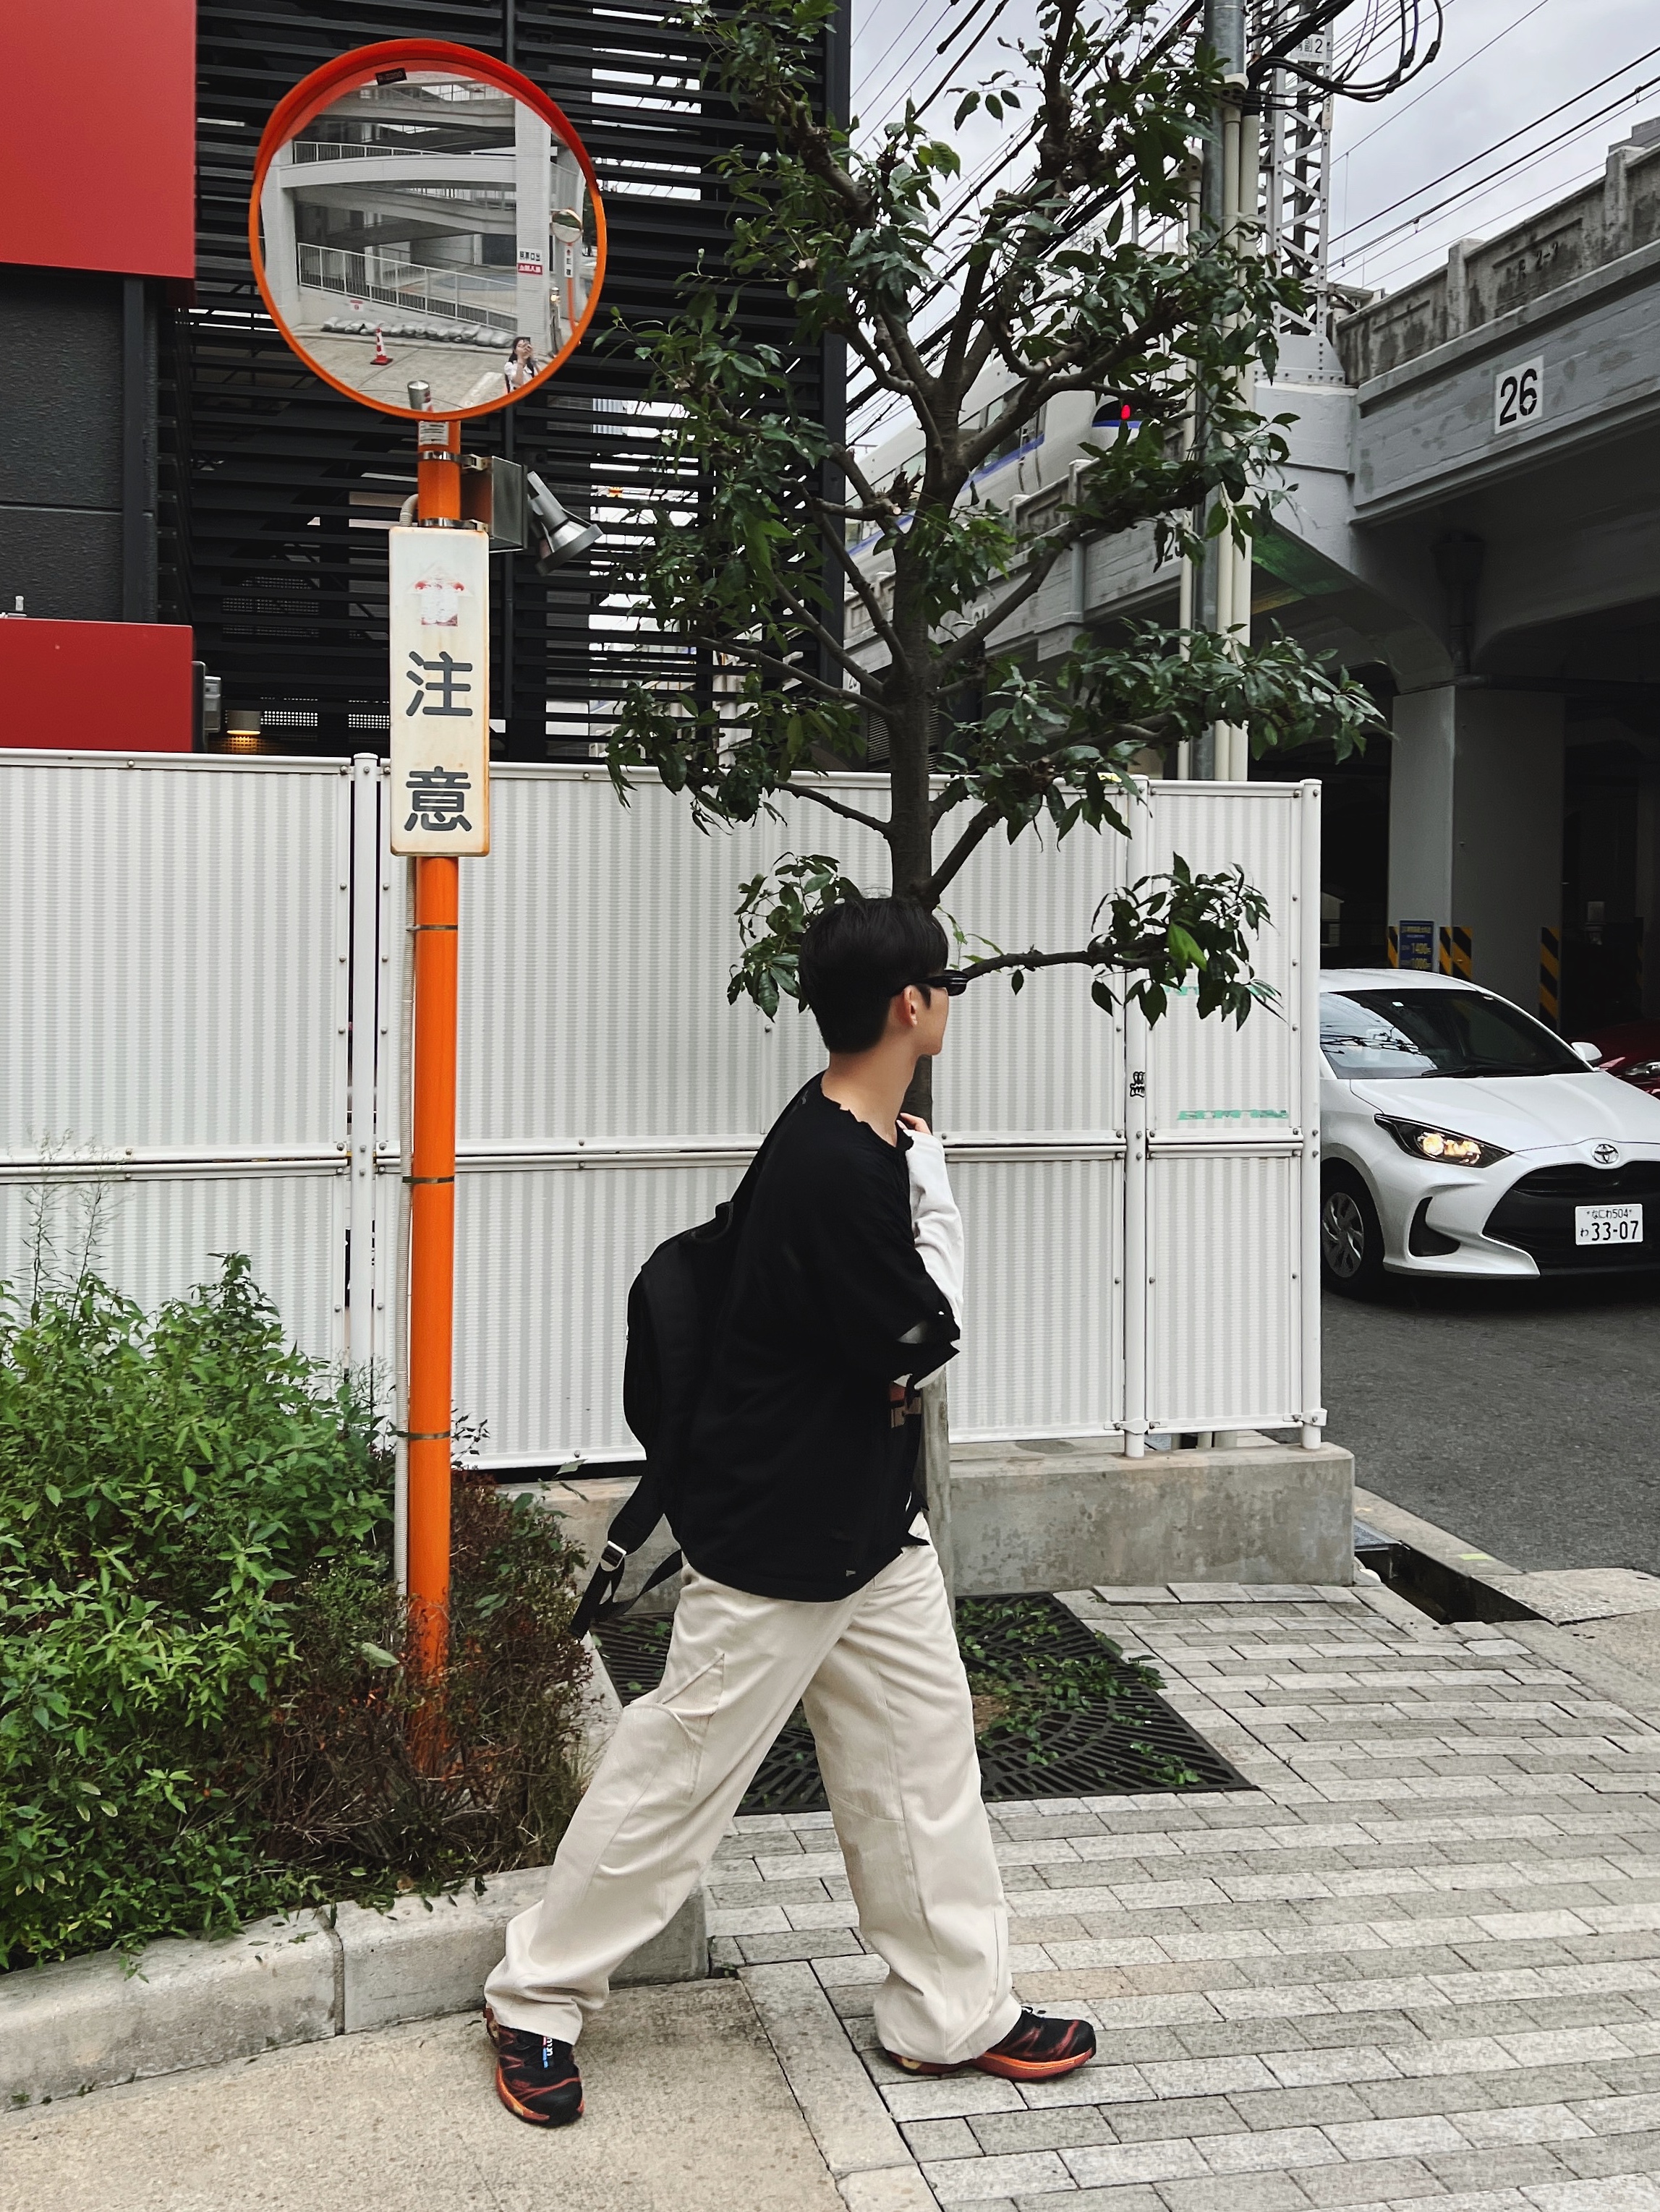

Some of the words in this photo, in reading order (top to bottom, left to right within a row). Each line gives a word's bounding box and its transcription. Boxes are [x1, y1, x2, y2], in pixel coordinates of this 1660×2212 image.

[1315, 38, 1323, 54] 2
[1499, 368, 1538, 427] 26
[404, 651, 473, 832] 注意
[1591, 1220, 1639, 1242] 33-07
